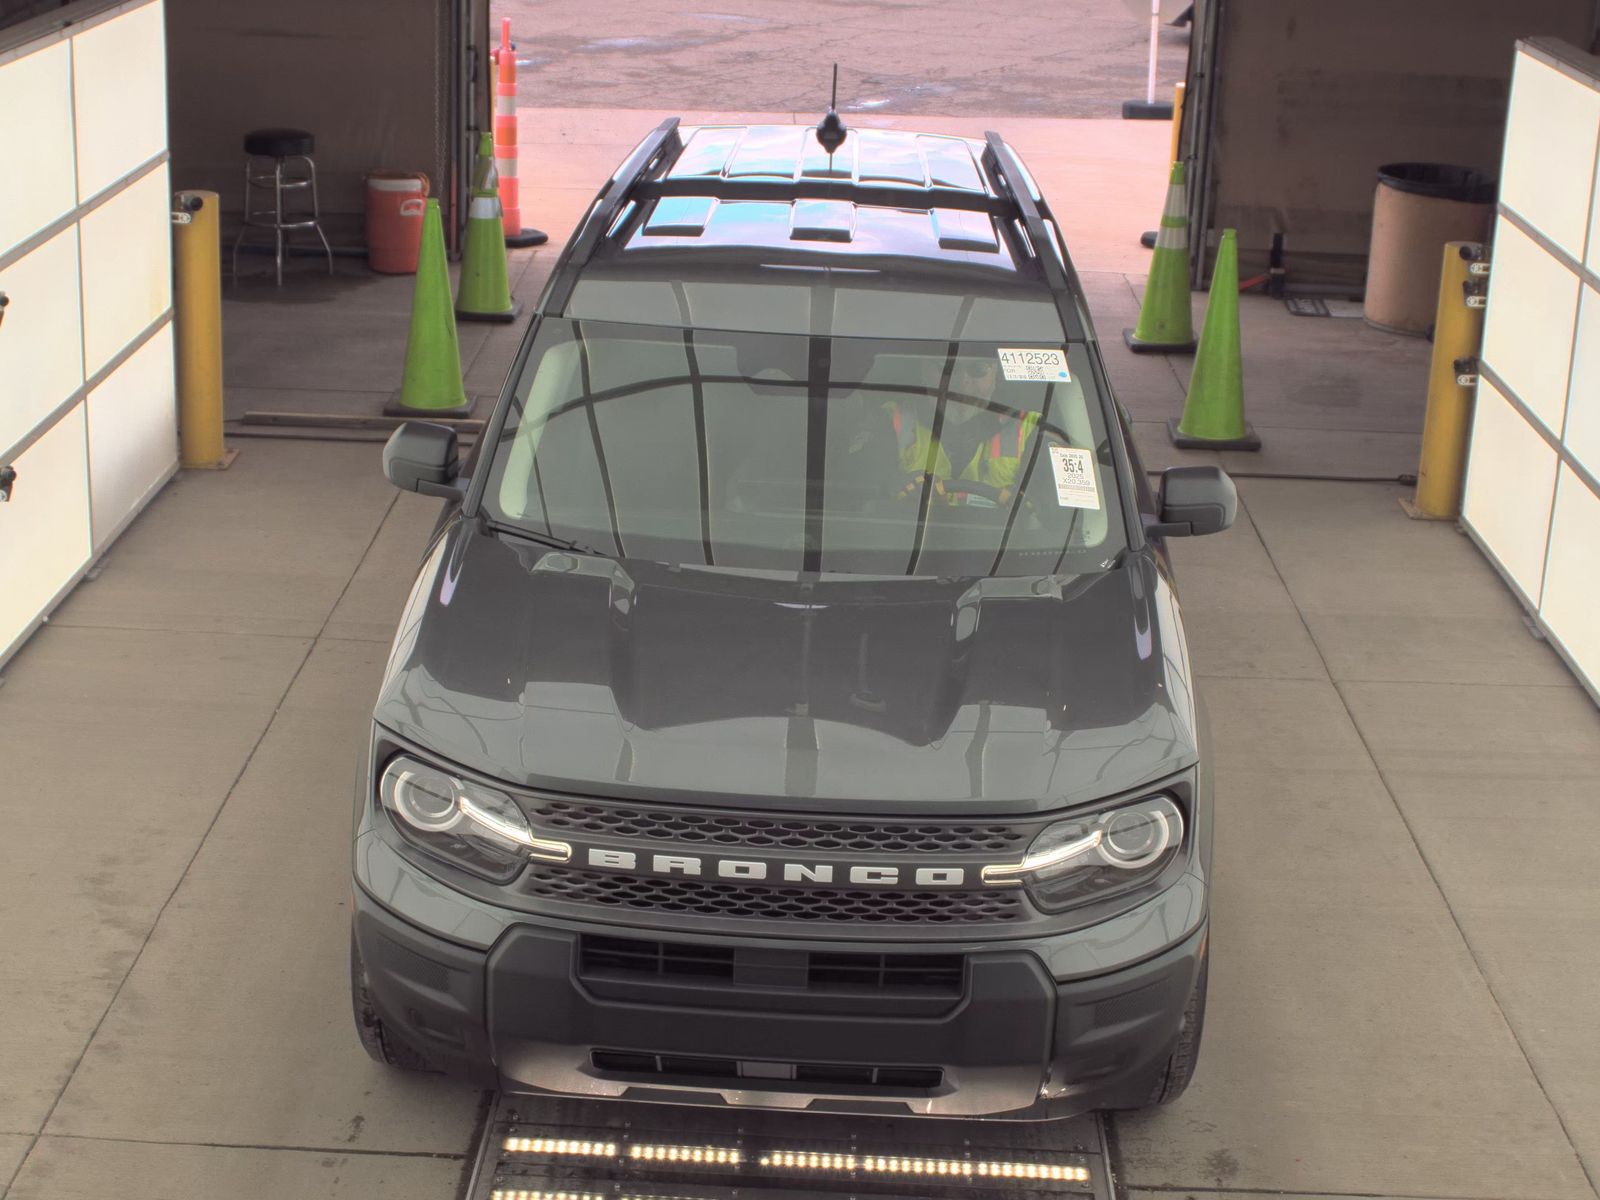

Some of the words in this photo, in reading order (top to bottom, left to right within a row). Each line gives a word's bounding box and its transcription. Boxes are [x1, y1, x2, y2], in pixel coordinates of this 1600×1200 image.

[1001, 352, 1060, 366] 4112523
[1062, 458, 1084, 473] 35:4
[588, 848, 965, 886] BRONCO
